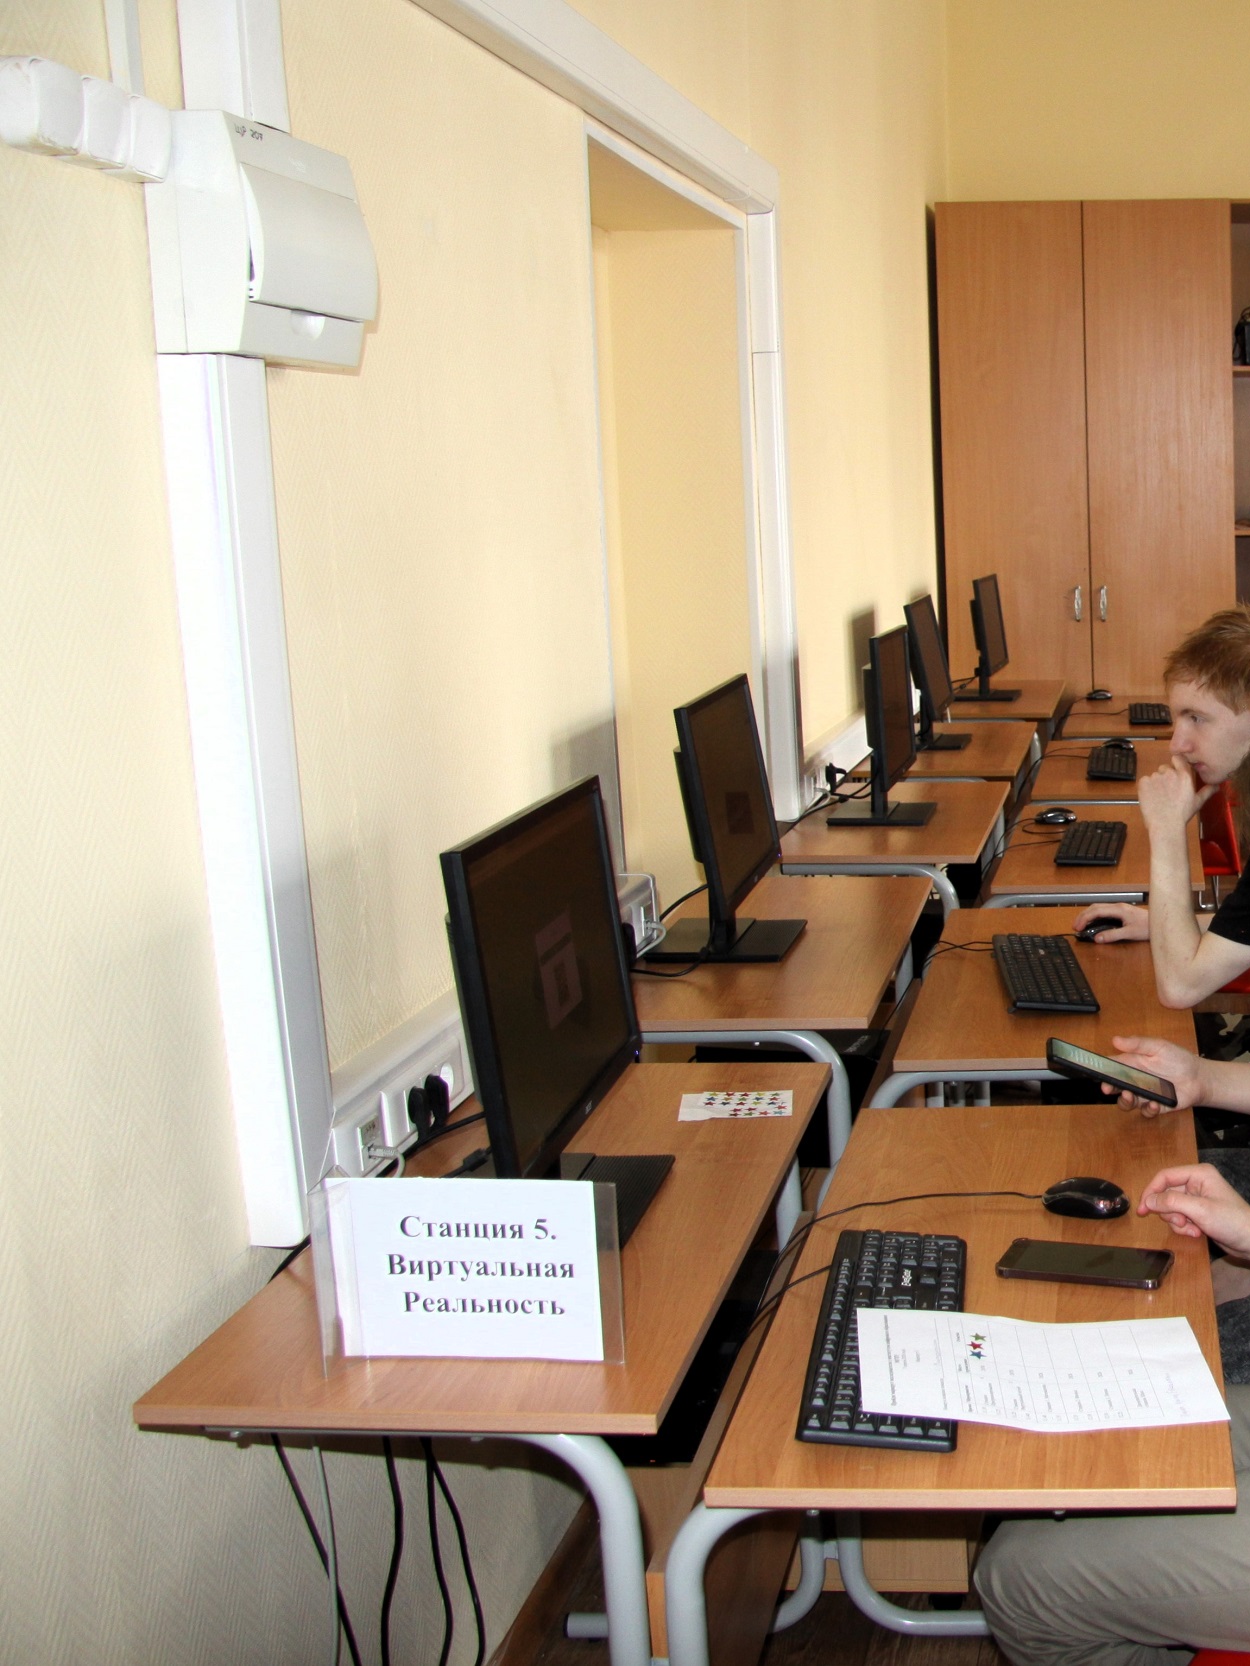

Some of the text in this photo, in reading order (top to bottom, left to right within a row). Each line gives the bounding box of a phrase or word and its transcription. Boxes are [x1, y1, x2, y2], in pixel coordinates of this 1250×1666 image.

[399, 1214, 558, 1241] Станция 5.
[387, 1253, 575, 1282] Виртуальная
[403, 1290, 566, 1316] Реальность
